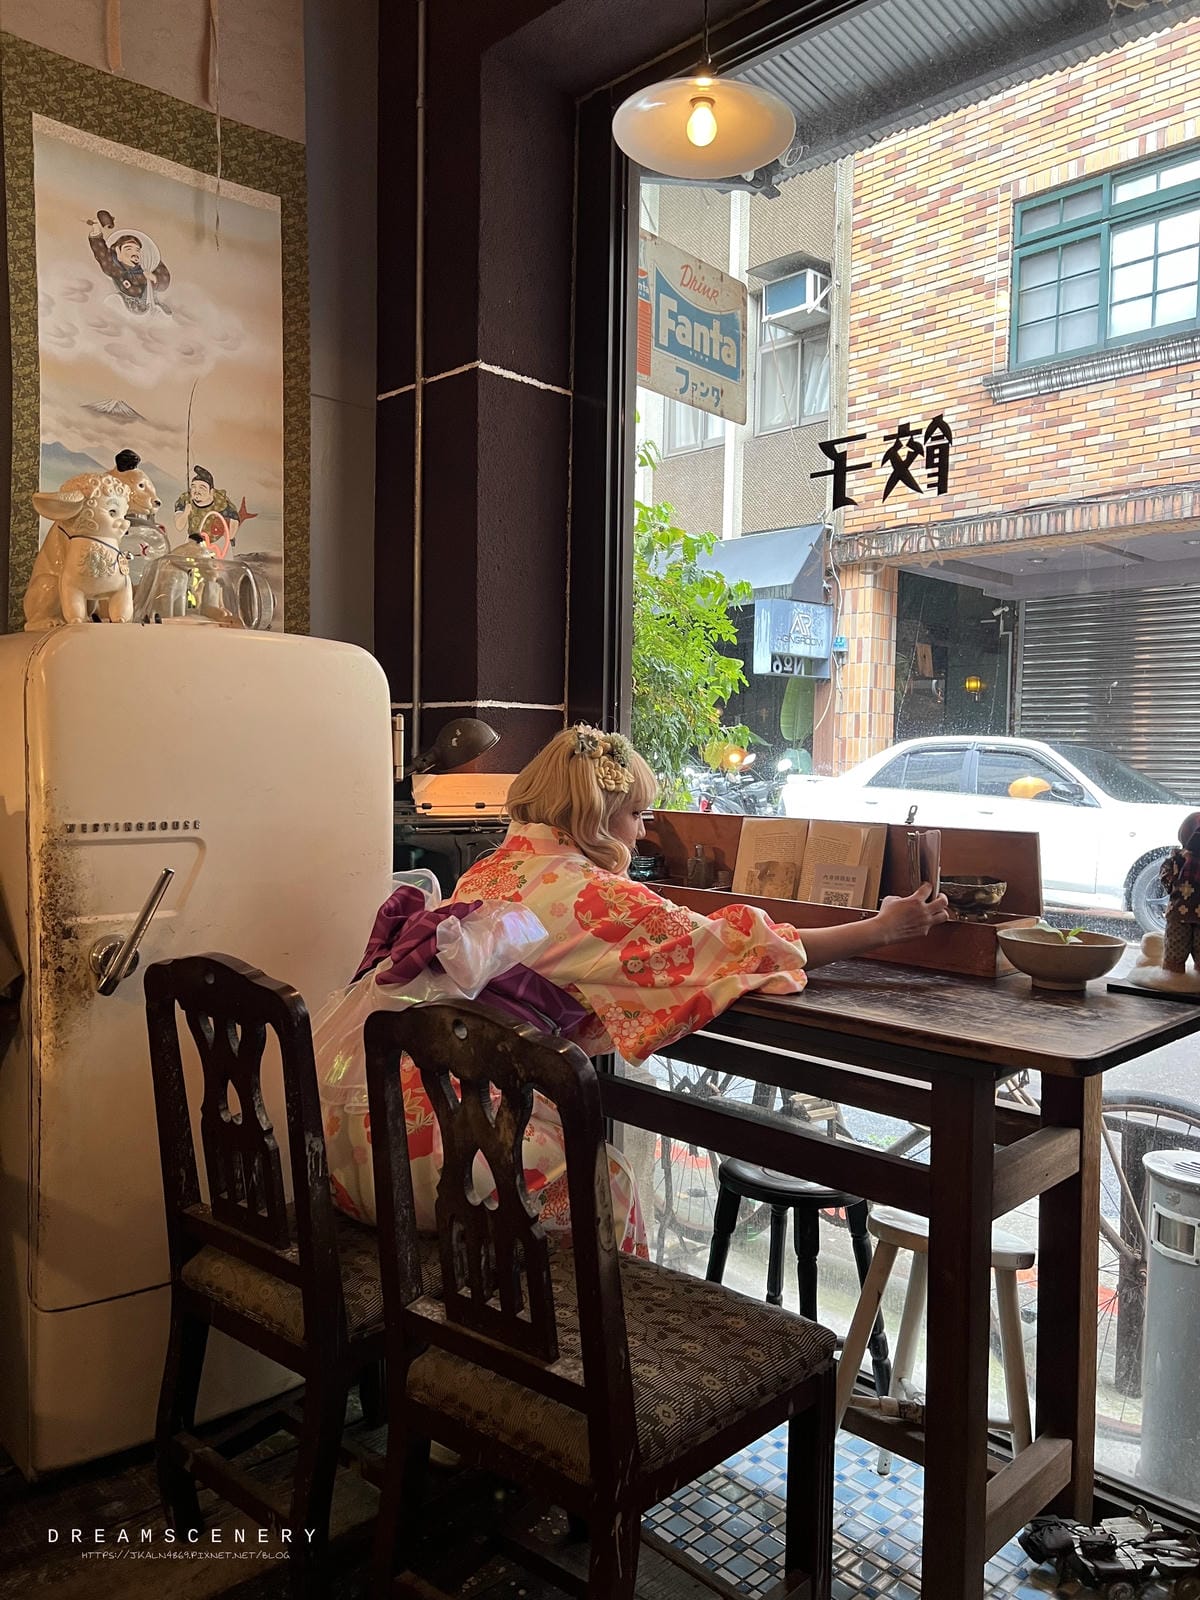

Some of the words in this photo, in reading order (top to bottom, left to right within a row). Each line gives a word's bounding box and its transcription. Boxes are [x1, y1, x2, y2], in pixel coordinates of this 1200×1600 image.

[659, 293, 737, 368] Fanta
[675, 366, 722, 408] ファンタ
[64, 820, 200, 834] WESTINGHOUSE
